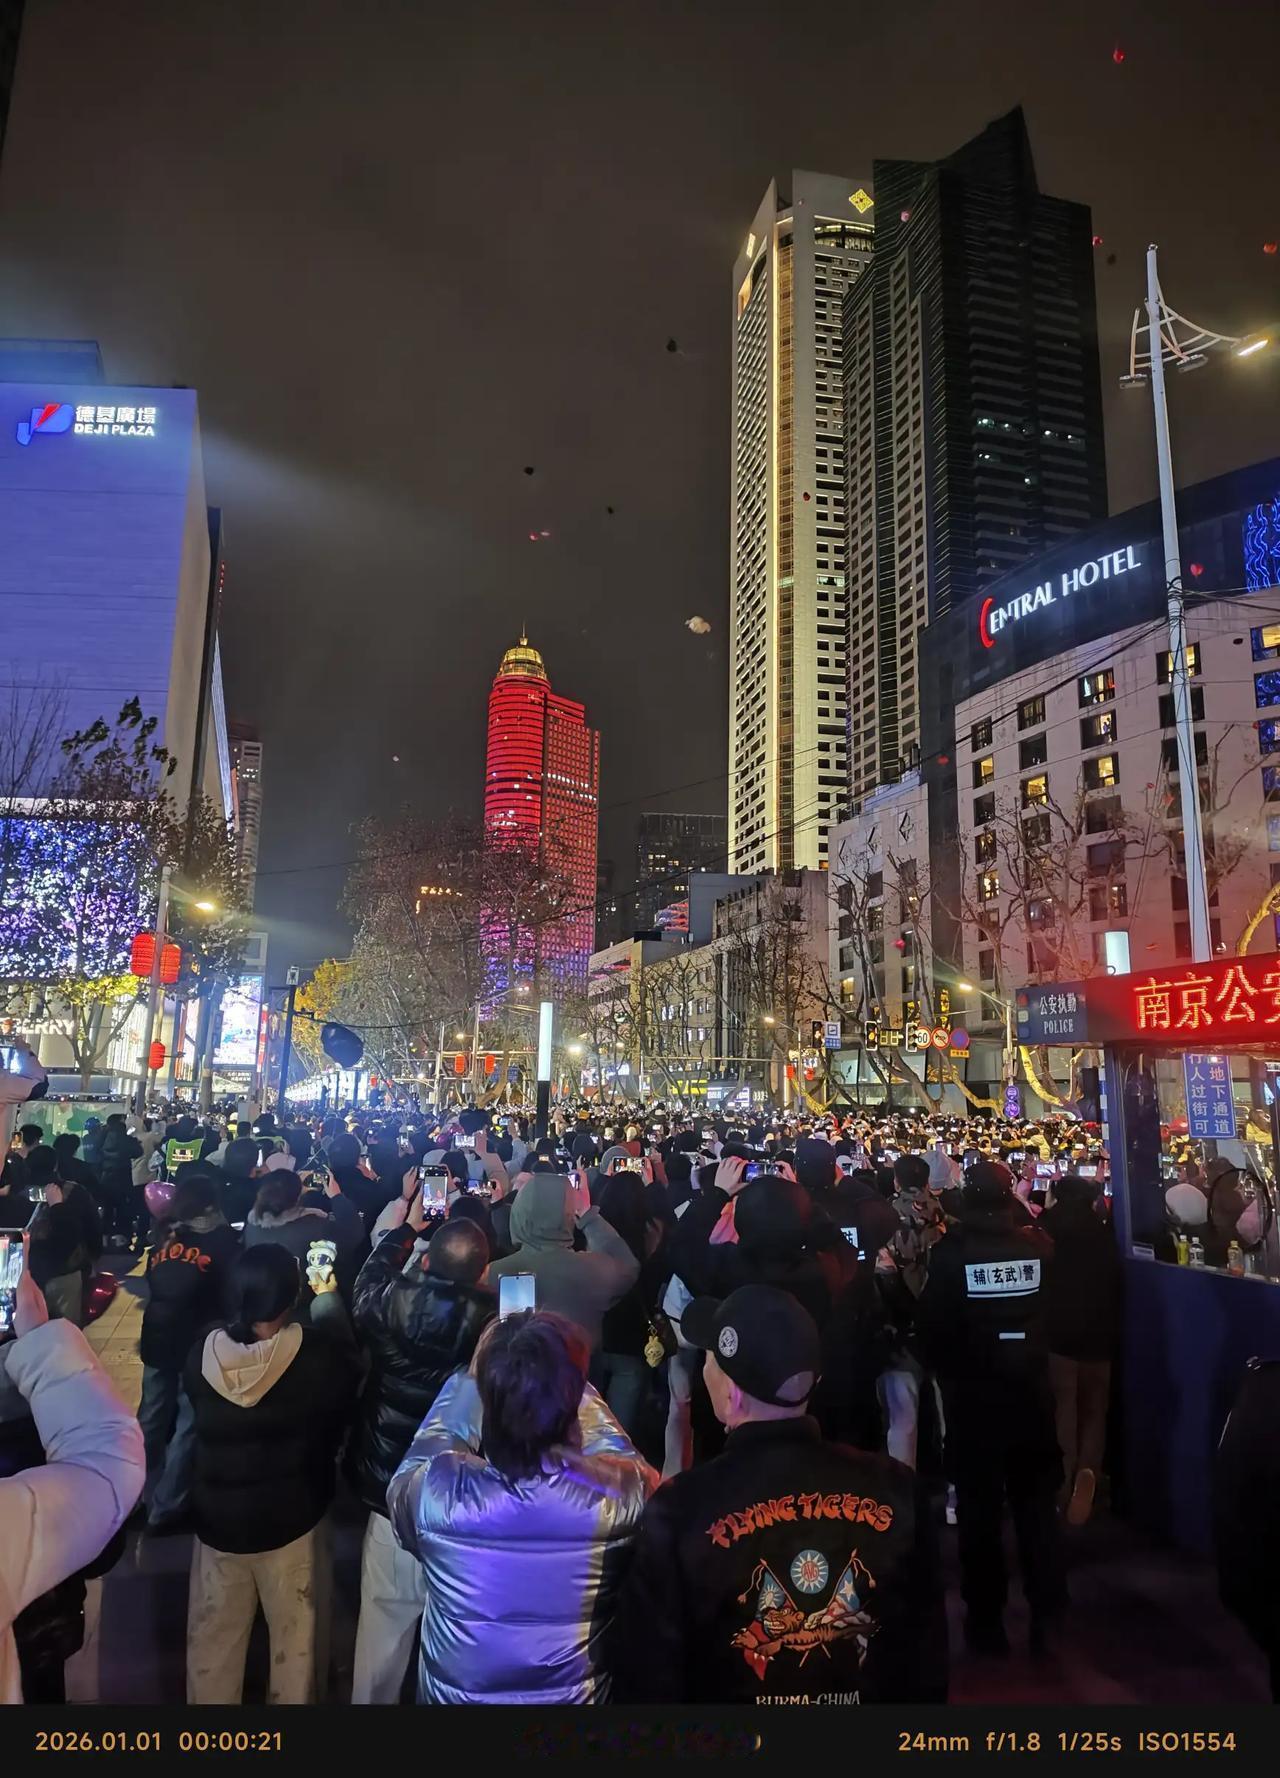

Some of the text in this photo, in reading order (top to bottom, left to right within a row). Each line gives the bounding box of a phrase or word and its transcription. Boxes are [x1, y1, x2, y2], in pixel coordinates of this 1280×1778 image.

[75, 405, 157, 424] 德基廣場
[74, 424, 155, 437] DEJI PLAZA
[979, 545, 1142, 649] CENTRAL HOTEL
[1039, 992, 1078, 1016] 公安执勤
[1043, 1020, 1075, 1035] POLICE
[917, 1032, 929, 1044] 60
[705, 1492, 895, 1548] FLYING TIGERS
